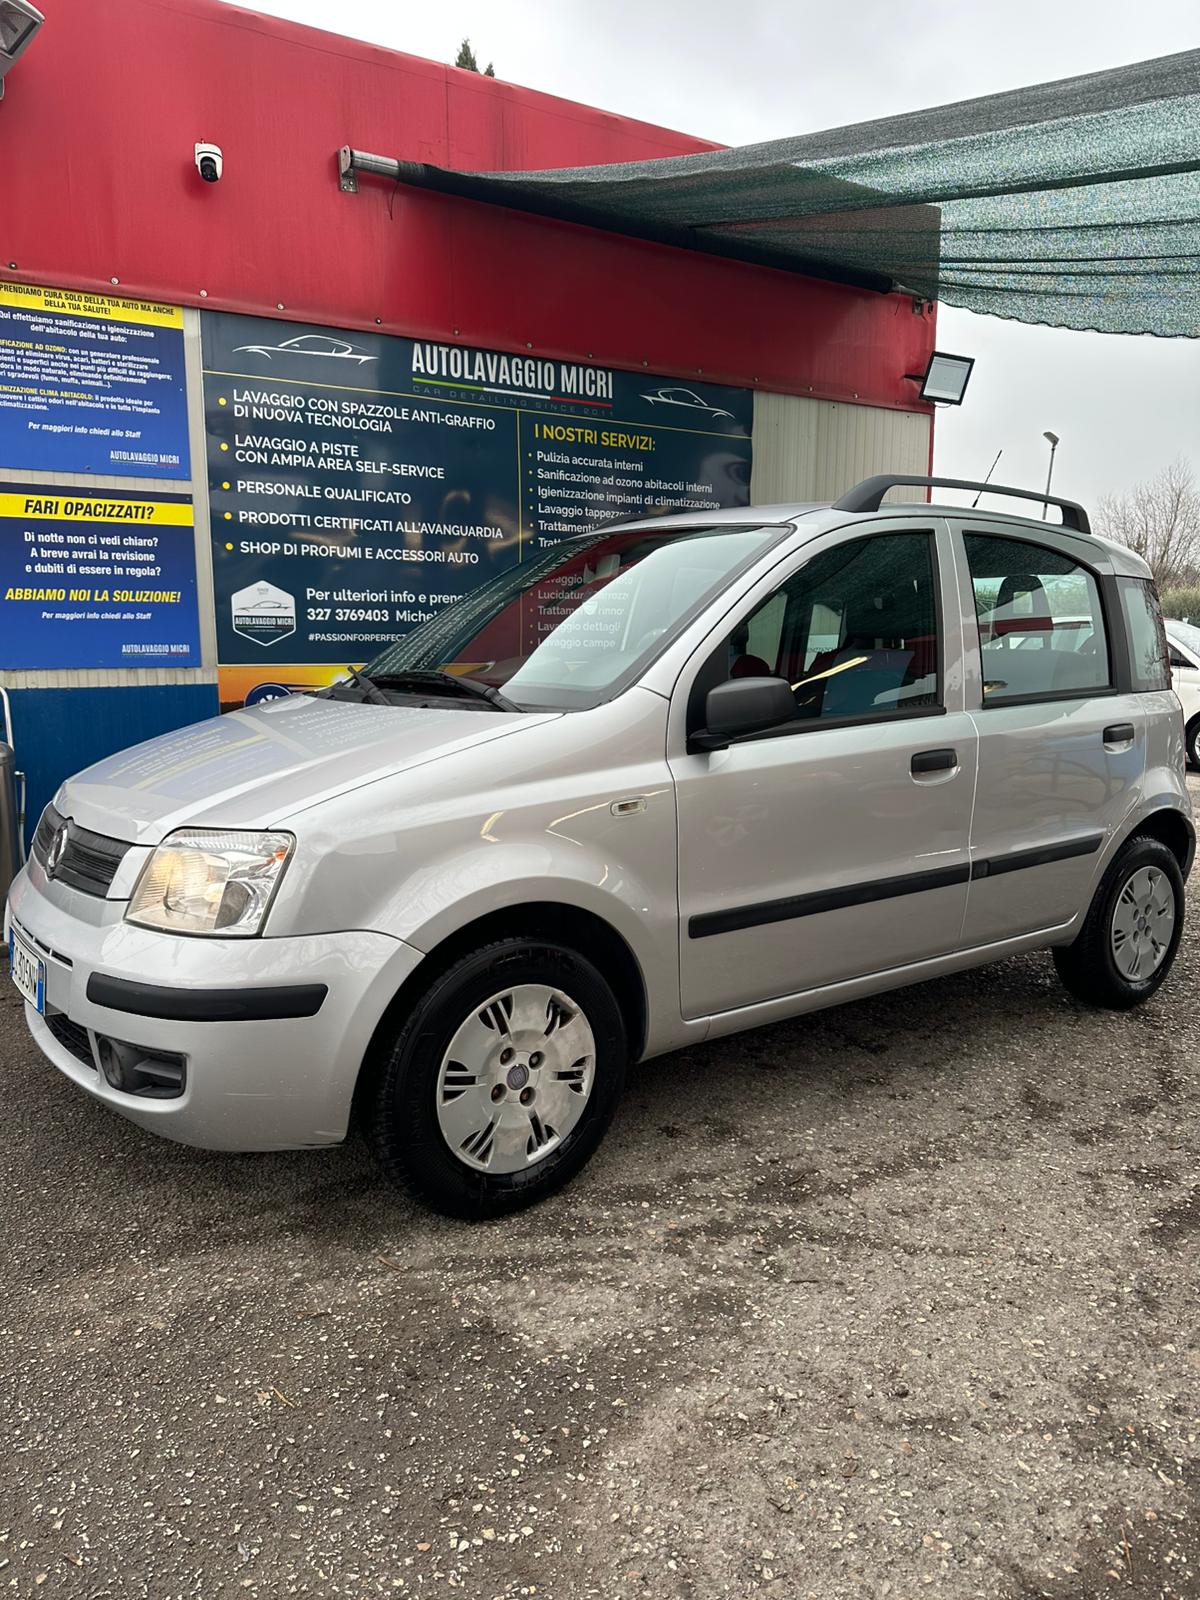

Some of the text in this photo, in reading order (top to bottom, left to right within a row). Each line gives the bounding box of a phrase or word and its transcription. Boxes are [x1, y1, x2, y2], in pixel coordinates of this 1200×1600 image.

[0, 284, 42, 296] PRENDIAMO
[44, 290, 62, 299] CURA
[64, 293, 82, 302] SOLO
[84, 296, 105, 305] DELLA
[107, 299, 120, 307] TUA
[122, 301, 139, 310] AUTO
[153, 306, 175, 315] ANCHE
[44, 299, 111, 314] DELLA TUA SALUTE!
[12, 312, 53, 324] effettuiamo
[55, 319, 100, 330] sanificazione
[108, 324, 154, 337] igienizzazione
[31, 324, 77, 336] dell'abitacolo
[79, 330, 96, 338] della
[0, 339, 33, 348] IFICAZIONE
[90, 351, 120, 359] generatore
[26, 350, 54, 358] eliminare
[412, 342, 613, 398] AUTOLAVAGGIO MICRI
[413, 385, 441, 395] CAR
[450, 390, 527, 406] DETAILING
[536, 401, 575, 412] SINCE
[234, 389, 496, 430] LAVAGGIO CON SPAZZOLE ANTI-GRAFFIO
[234, 405, 392, 432] DI NUOVA TECNOLOGIA
[28, 422, 142, 439] Per maggiori info chiedi allo Staff
[534, 423, 656, 451] I NOSTRI SERVIZI:
[236, 434, 359, 457] LAVAGGIO A PISTE
[110, 450, 179, 464] AUTOLAVAGGIO MICRI
[236, 450, 444, 479] CON AMPIA AREA SELF-SERVICE
[537, 451, 643, 471] Pulizia accurata interni
[537, 469, 713, 493] Sanificazione ad ozono abitacoli interni
[237, 480, 411, 504] PERSONALE QUALIFICATO
[538, 486, 720, 509] Igienizzazione impianti di climatizzazione
[24, 499, 154, 519] FARI OPACIZZATI?
[538, 503, 583, 517] Lavaggio
[239, 511, 503, 539] PRODOTTI CERTIFICATI ALL'AVANGUARDIA
[538, 520, 595, 533] Trattamenti
[24, 531, 158, 546] Di notte non ci vedi chiaro?
[30, 547, 155, 561] A breve avrai la revisione
[240, 541, 479, 564] SHOP DI PROFUMI E ACCESSORI AUTO
[25, 563, 161, 578] e dubiti di essere in regola?
[5, 588, 181, 602] ABBIAMO NOI LA SOLUZIONE!
[306, 588, 329, 600] Per
[333, 589, 387, 602] ulteriori
[391, 590, 416, 603] info
[418, 594, 427, 603] e
[42, 611, 54, 619] Per
[55, 612, 85, 621] maggiori
[136, 612, 152, 620] Staff
[235, 617, 276, 625] AUTOLAVAGGIO
[306, 608, 331, 621] 327
[335, 609, 389, 622] 3769403
[538, 621, 581, 632] Lavaggio
[122, 644, 189, 653] AUTOLAVAGGIO MICRI
